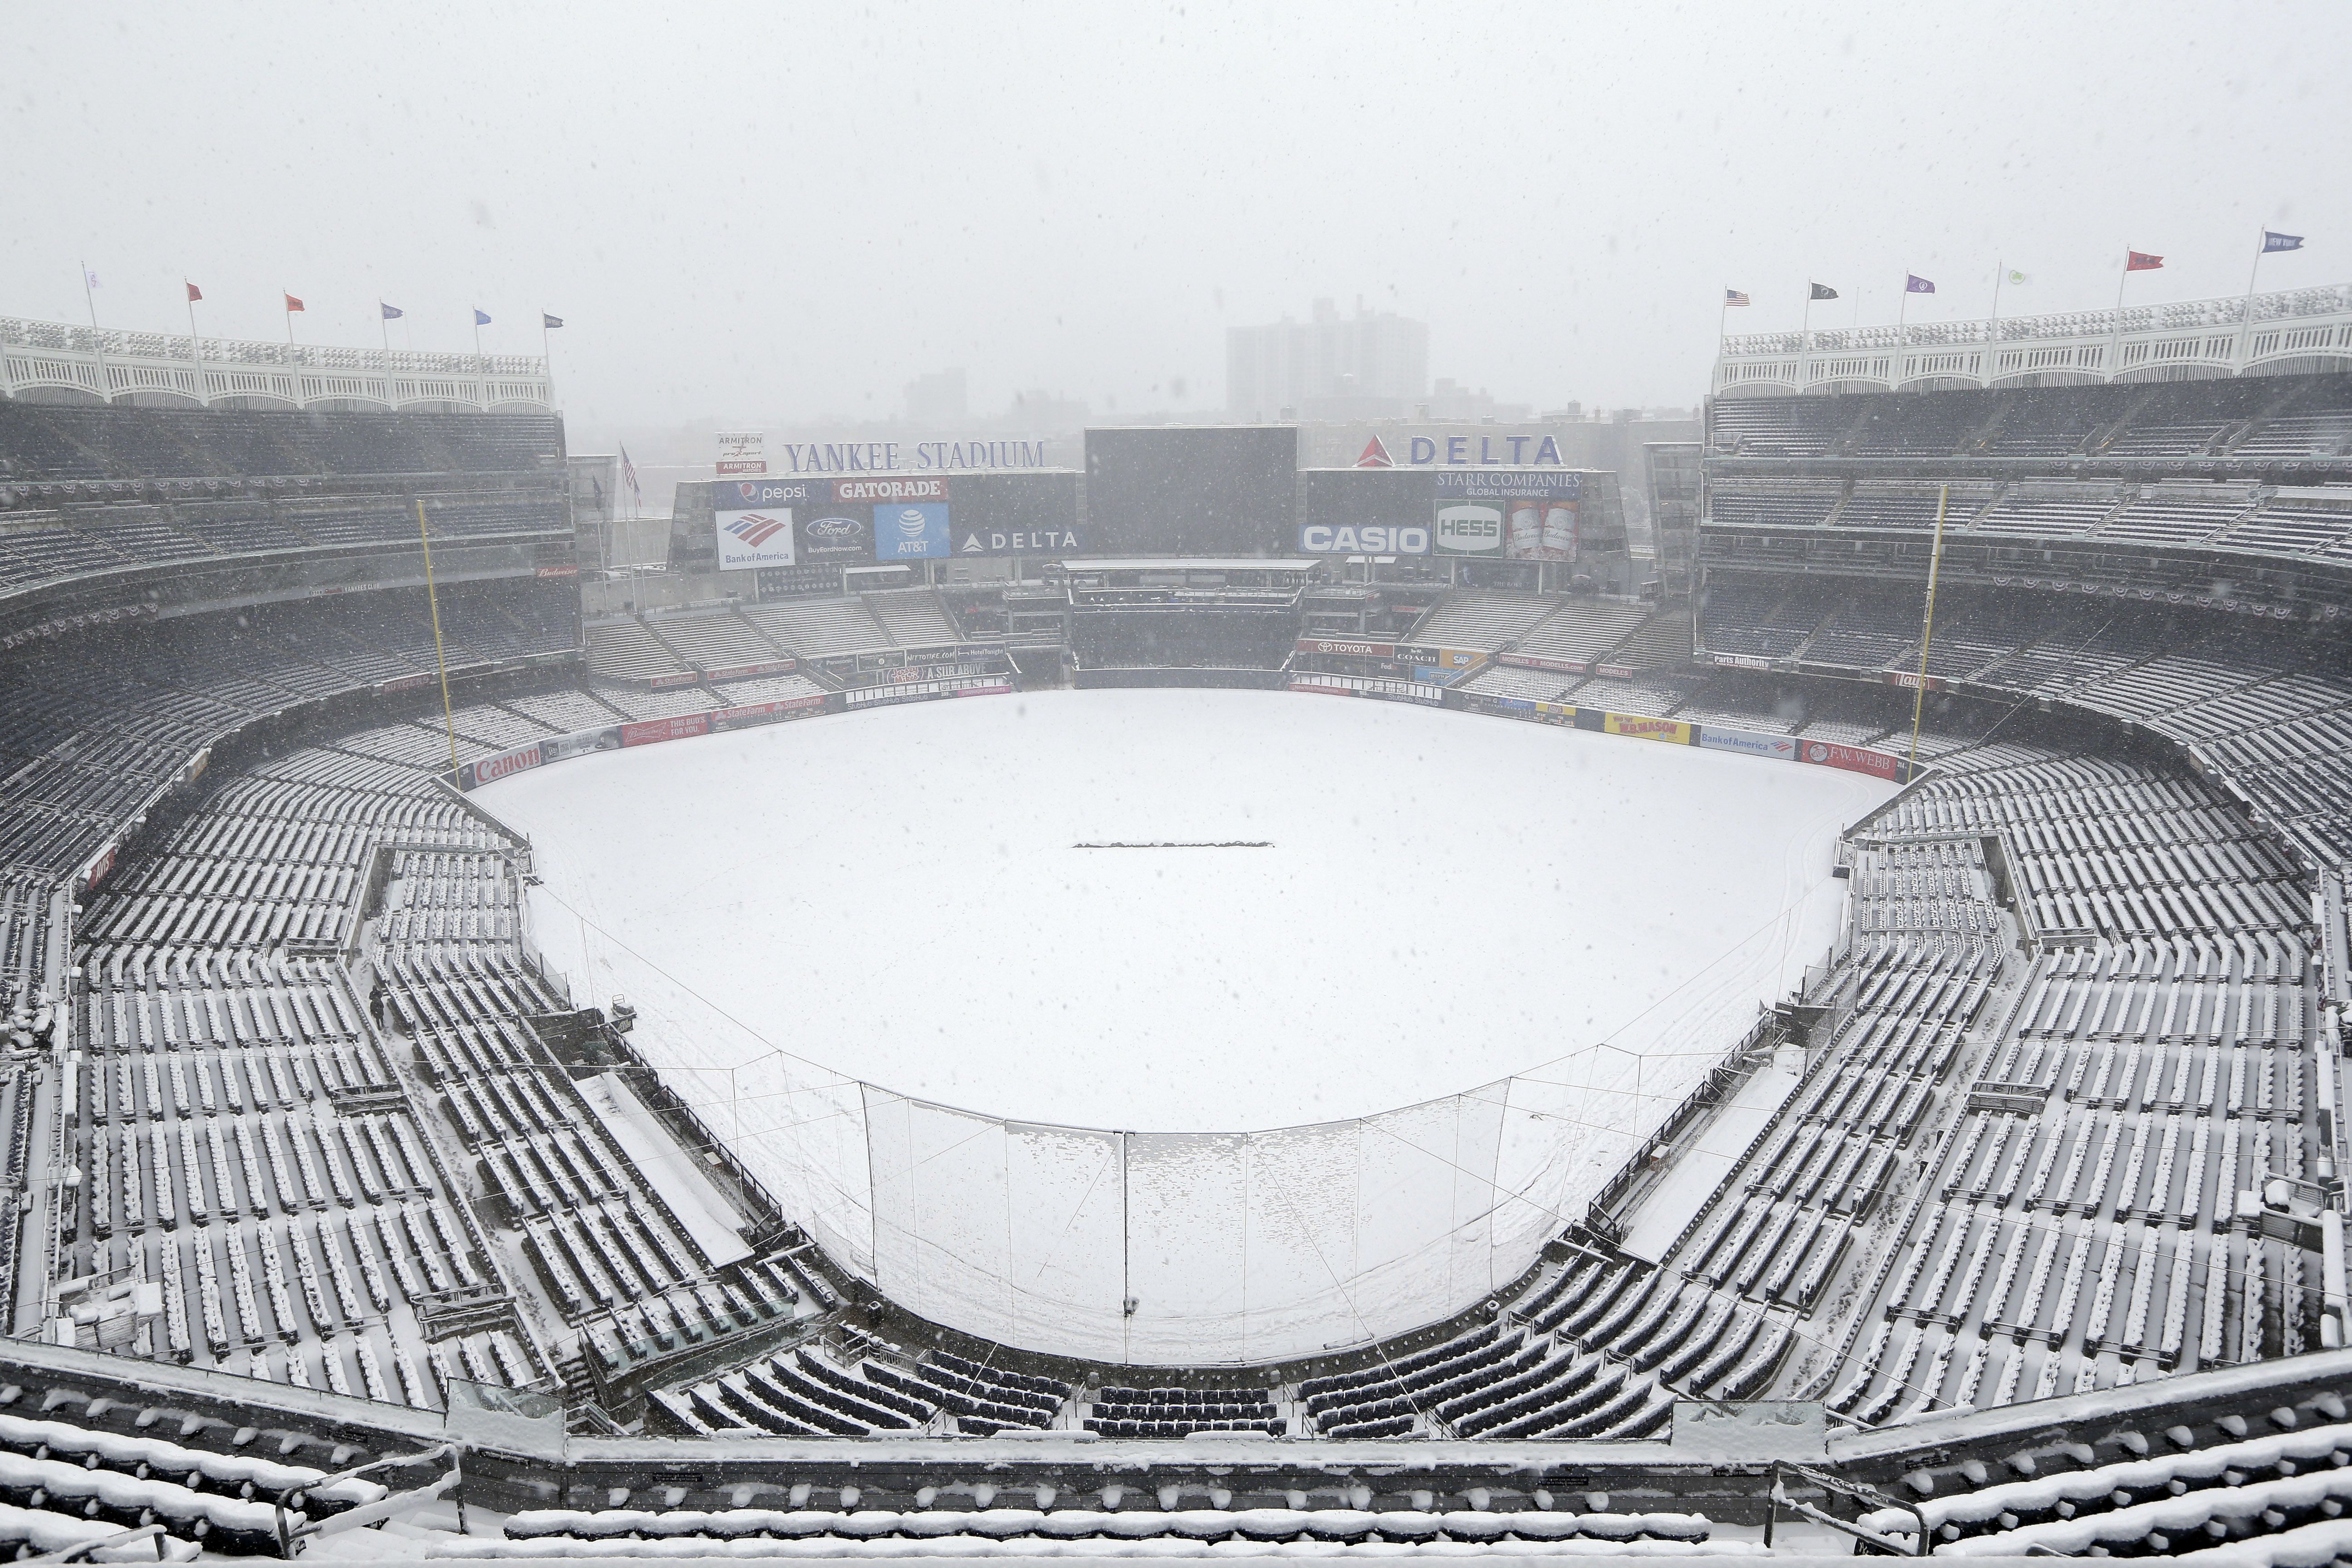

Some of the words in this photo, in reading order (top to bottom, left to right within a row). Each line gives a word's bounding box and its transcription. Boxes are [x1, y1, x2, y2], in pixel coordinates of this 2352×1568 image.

[783, 442, 900, 472] YANKEE
[916, 441, 1045, 469] STADIUM
[1411, 435, 1563, 465] DELTA
[1438, 473, 1487, 486] STARR
[1490, 473, 1580, 488] COMPANIES
[763, 484, 806, 501] pepsi
[840, 480, 941, 498] GATORADE
[1466, 488, 1499, 496] GLOBAL
[1501, 489, 1549, 497] INSURANCE
[817, 521, 851, 535] Ford
[1441, 519, 1497, 537] HESS
[992, 531, 1078, 549] DELTA
[1303, 526, 1427, 553] CASIO
[897, 541, 929, 553] AT&T
[725, 554, 745, 563] Bank
[747, 554, 756, 562] of
[755, 552, 789, 561] America
[537, 568, 578, 577] Budweiser
[1333, 644, 1372, 653] TOYOTA
[907, 651, 955, 661] NITTOTIRE.COM
[1397, 654, 1436, 662] COACH
[1453, 656, 1469, 664] SAP
[1735, 657, 1769, 668] Authority
[1502, 656, 1529, 664] MODELL'S
[1540, 661, 1583, 671] MODELLS.com
[892, 667, 918, 677] Jersey
[1600, 668, 1628, 676] MODELL'S
[902, 695, 928, 703] StubHub
[1388, 695, 1412, 703] StubHub
[1415, 698, 1438, 706] StubHub
[687, 716, 705, 725] BUD'S
[1702, 733, 1724, 744] Bank
[1731, 738, 1768, 751] America
[476, 747, 540, 782] Canon
[1855, 751, 1890, 769] WEBB
[96, 854, 109, 882] AVIS
